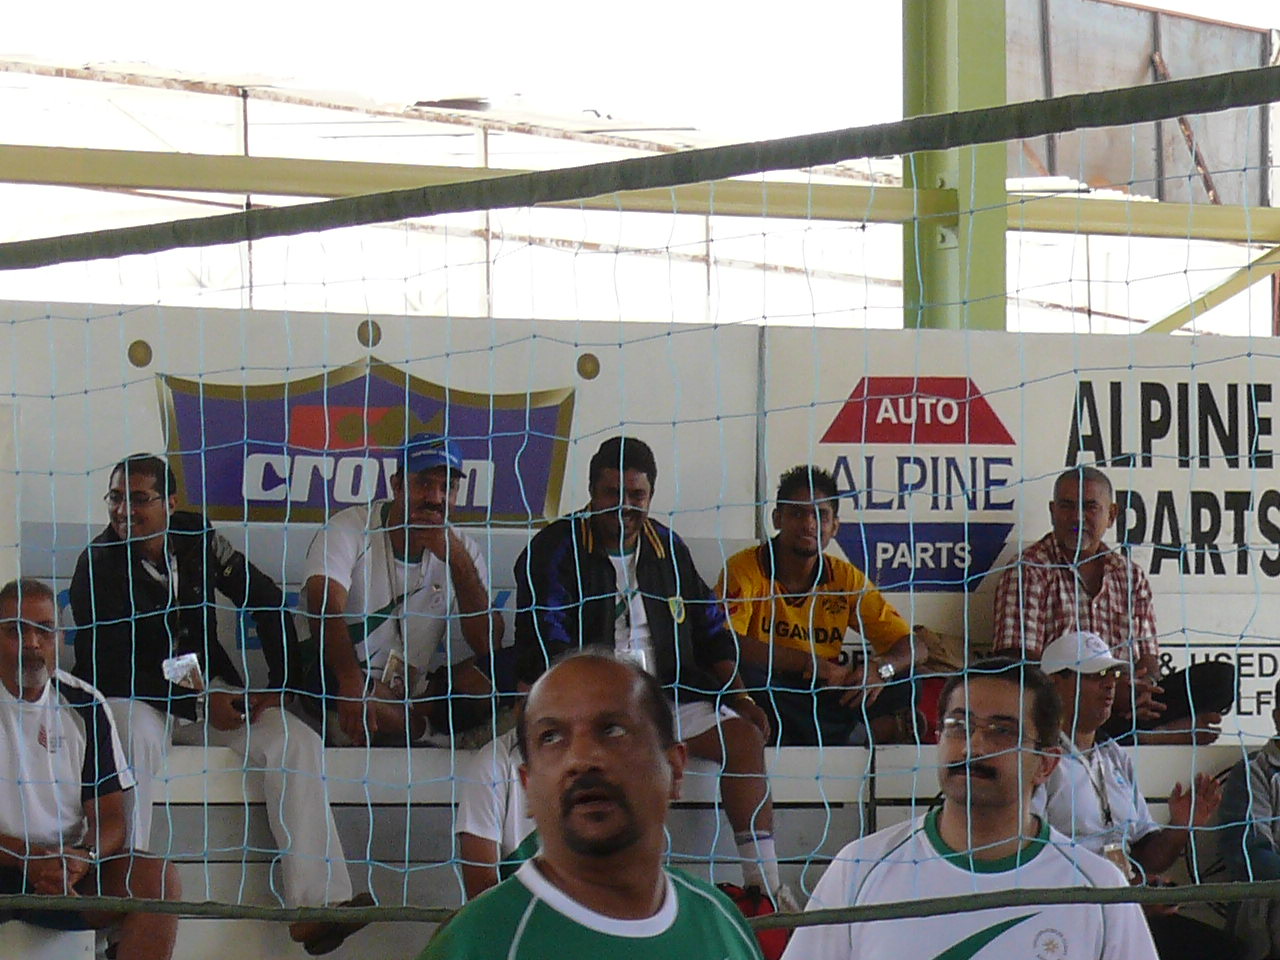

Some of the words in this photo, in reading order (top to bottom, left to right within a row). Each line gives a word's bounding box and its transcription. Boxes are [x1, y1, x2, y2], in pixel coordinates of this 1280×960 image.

[876, 397, 959, 426] AUTO
[1064, 380, 1274, 470] ALPINE
[241, 452, 495, 506] cron
[831, 455, 1015, 511] ALPINE
[876, 543, 973, 570] PARTS
[761, 616, 843, 644] UGANDA
